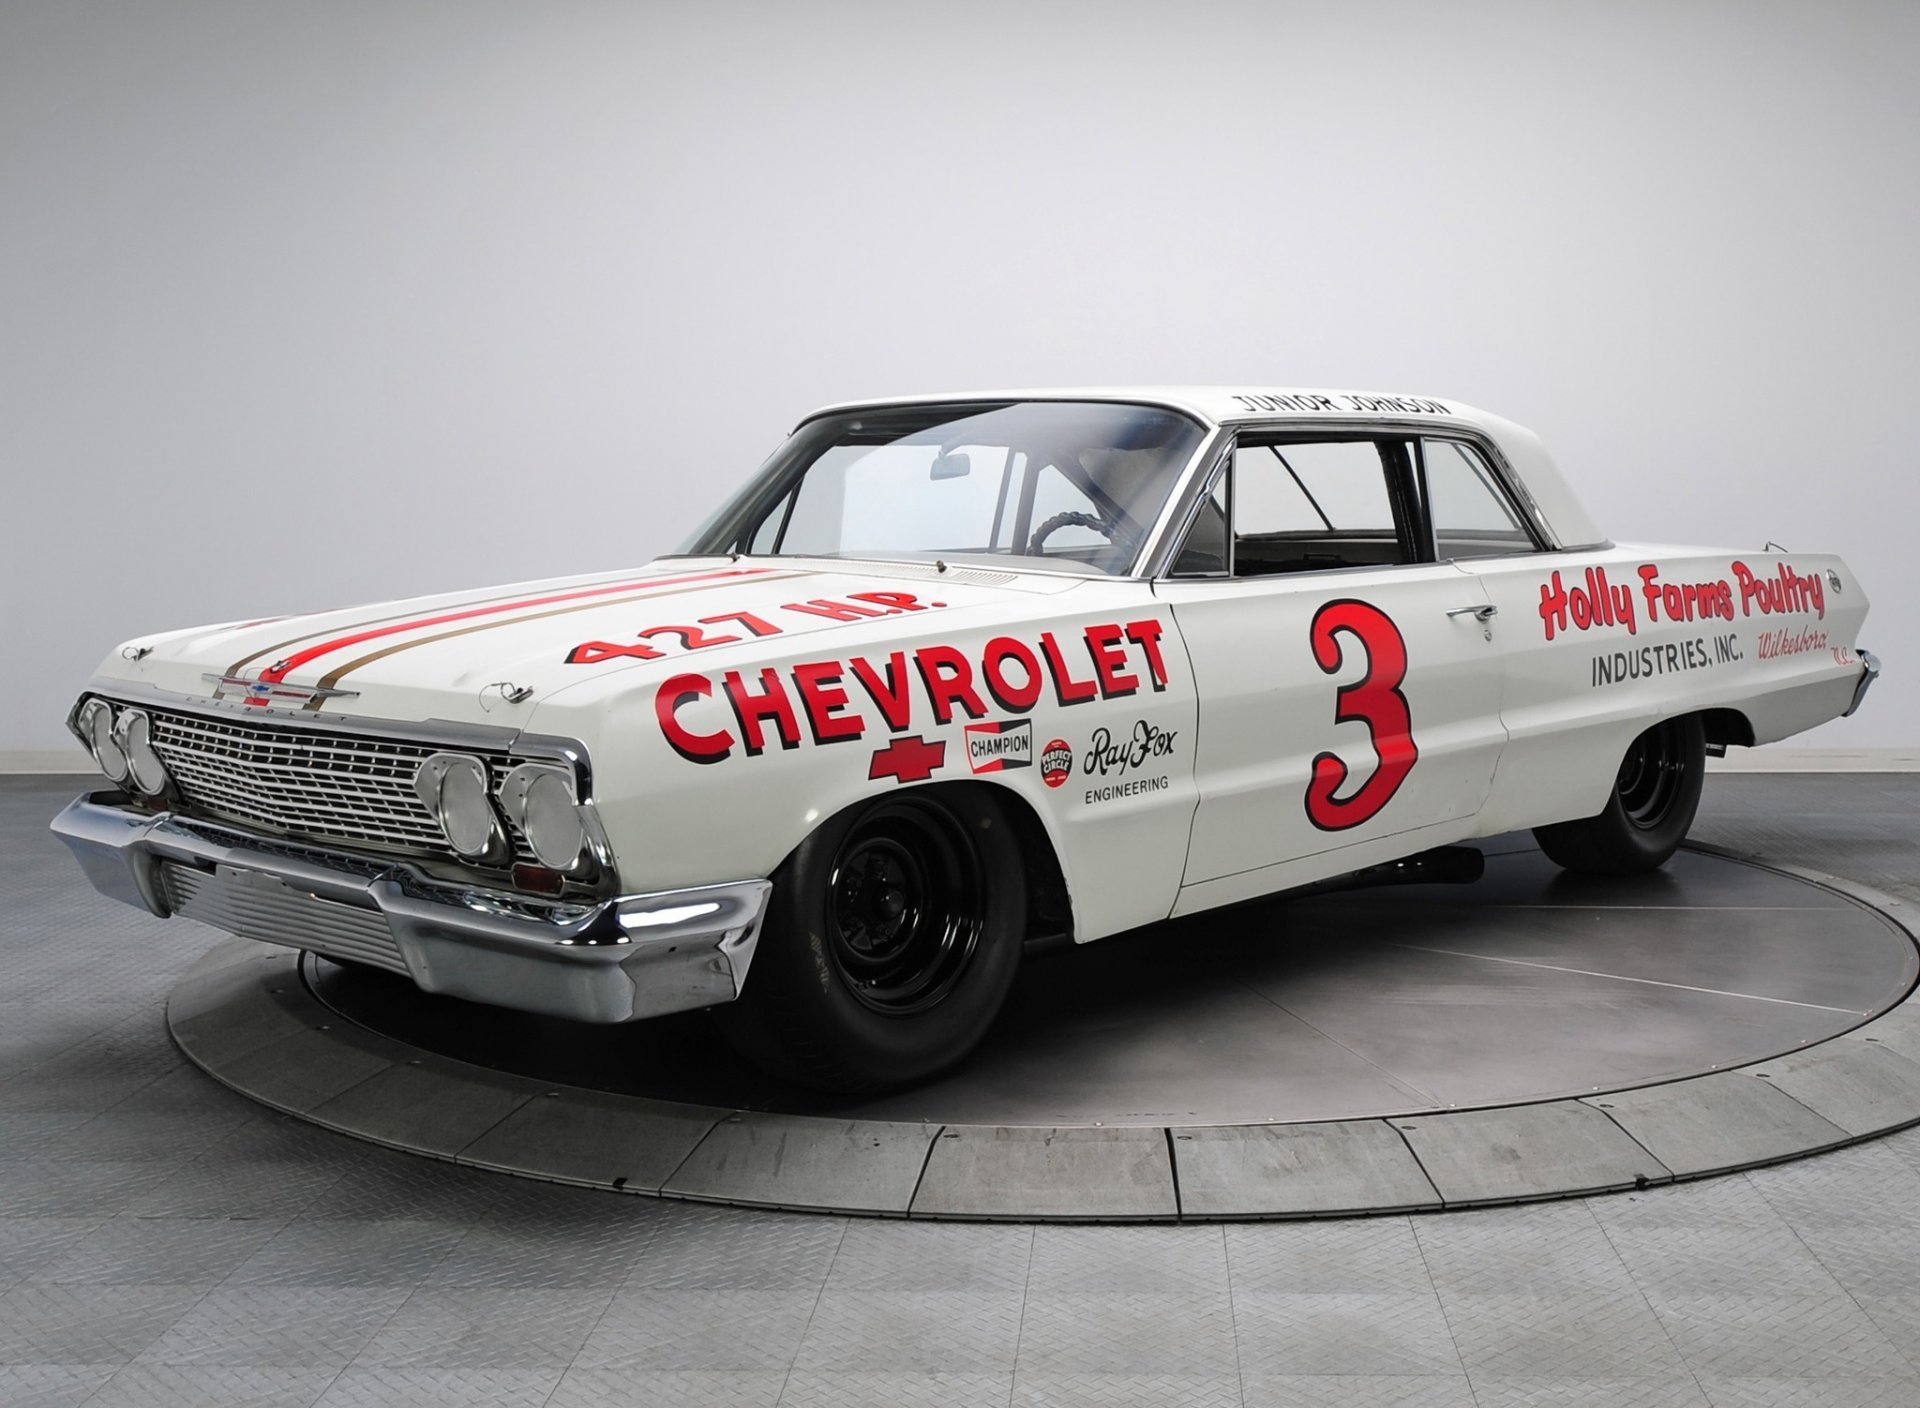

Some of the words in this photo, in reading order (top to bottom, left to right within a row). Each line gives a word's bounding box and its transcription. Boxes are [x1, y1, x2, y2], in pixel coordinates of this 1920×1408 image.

[1231, 394, 1343, 412] JUNIOR
[1339, 394, 1452, 415] JOHNSON
[1539, 566, 1636, 641] Holly
[1638, 563, 1734, 622] Farms
[1731, 560, 1825, 621] Poultry
[563, 610, 784, 664] 427
[1592, 637, 1713, 687] INDUSTRIES,
[1713, 633, 1744, 665] INC.
[654, 619, 1170, 764] CHEVROLET
[1303, 598, 1418, 832] 3
[970, 734, 1029, 758] CHAMPION
[1042, 750, 1072, 765] PERFECT
[1043, 759, 1070, 774] CIRCLE
[1085, 775, 1169, 805] ENGINEERING
